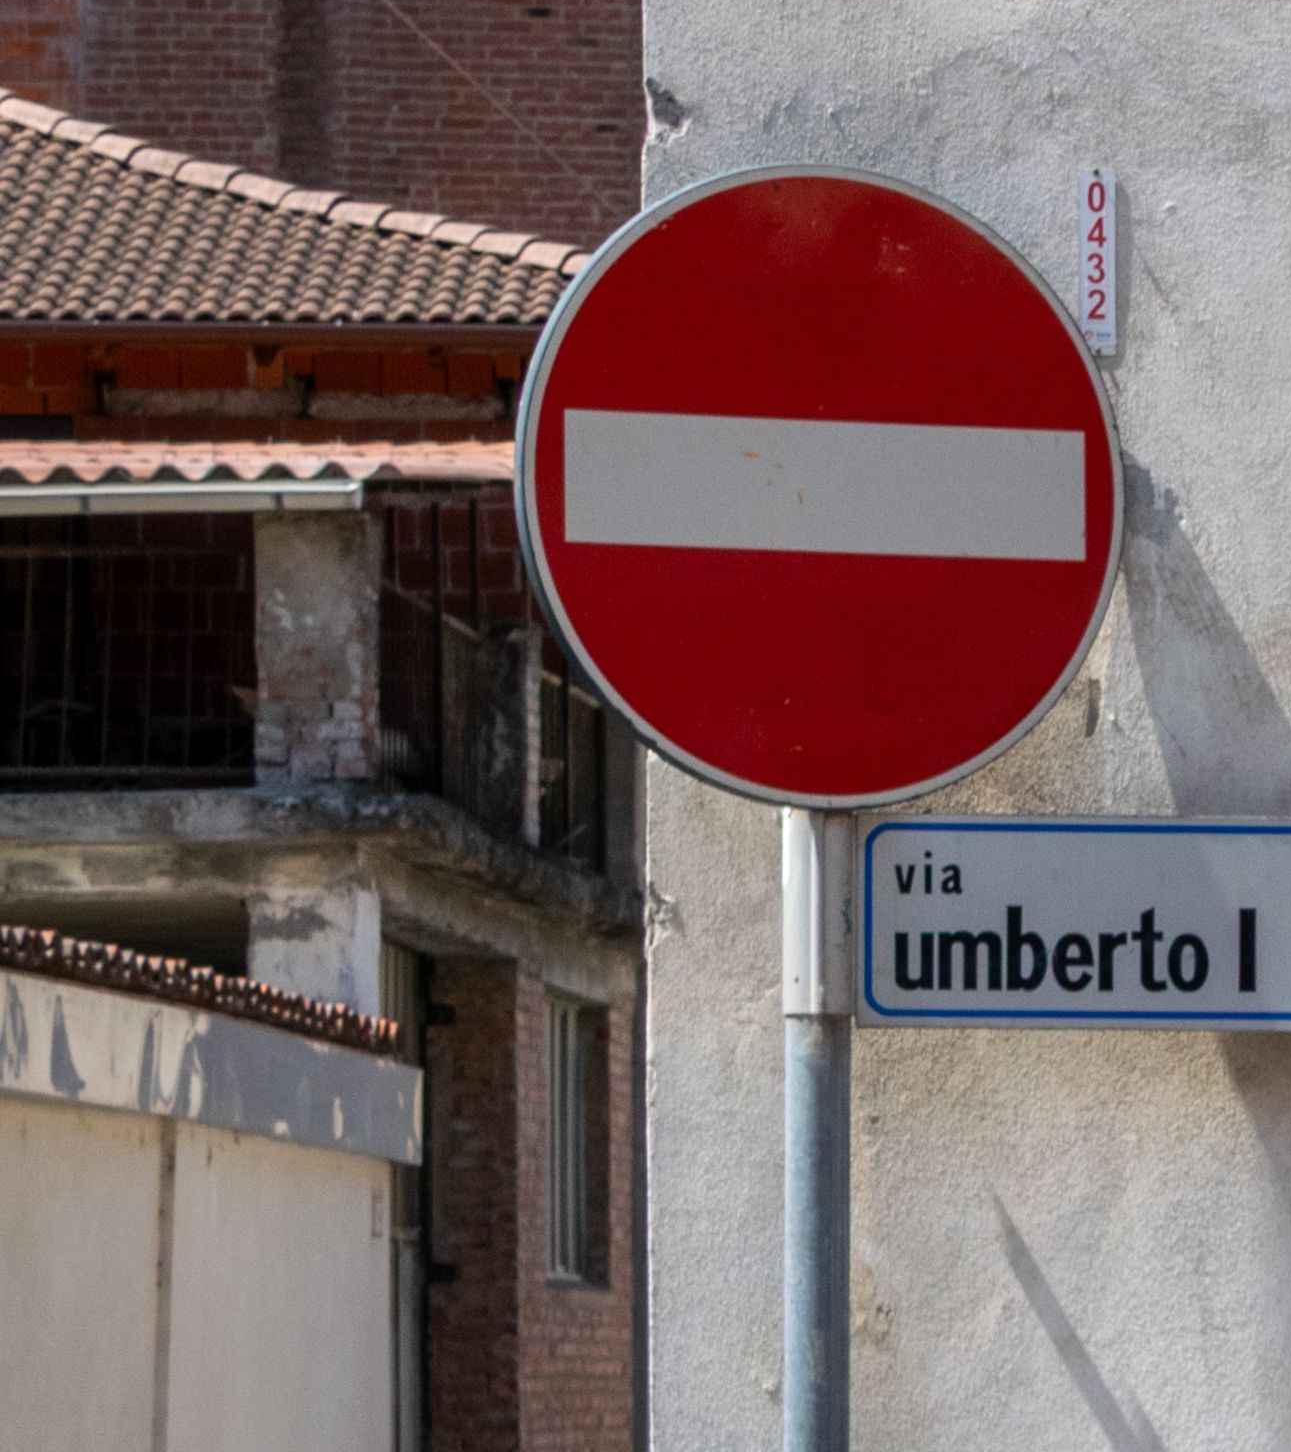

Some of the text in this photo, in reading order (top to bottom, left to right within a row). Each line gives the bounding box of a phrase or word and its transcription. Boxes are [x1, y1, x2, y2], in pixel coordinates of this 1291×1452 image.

[1087, 182, 1107, 320] 0432
[894, 850, 963, 895] via
[894, 905, 1257, 993] umberto I
